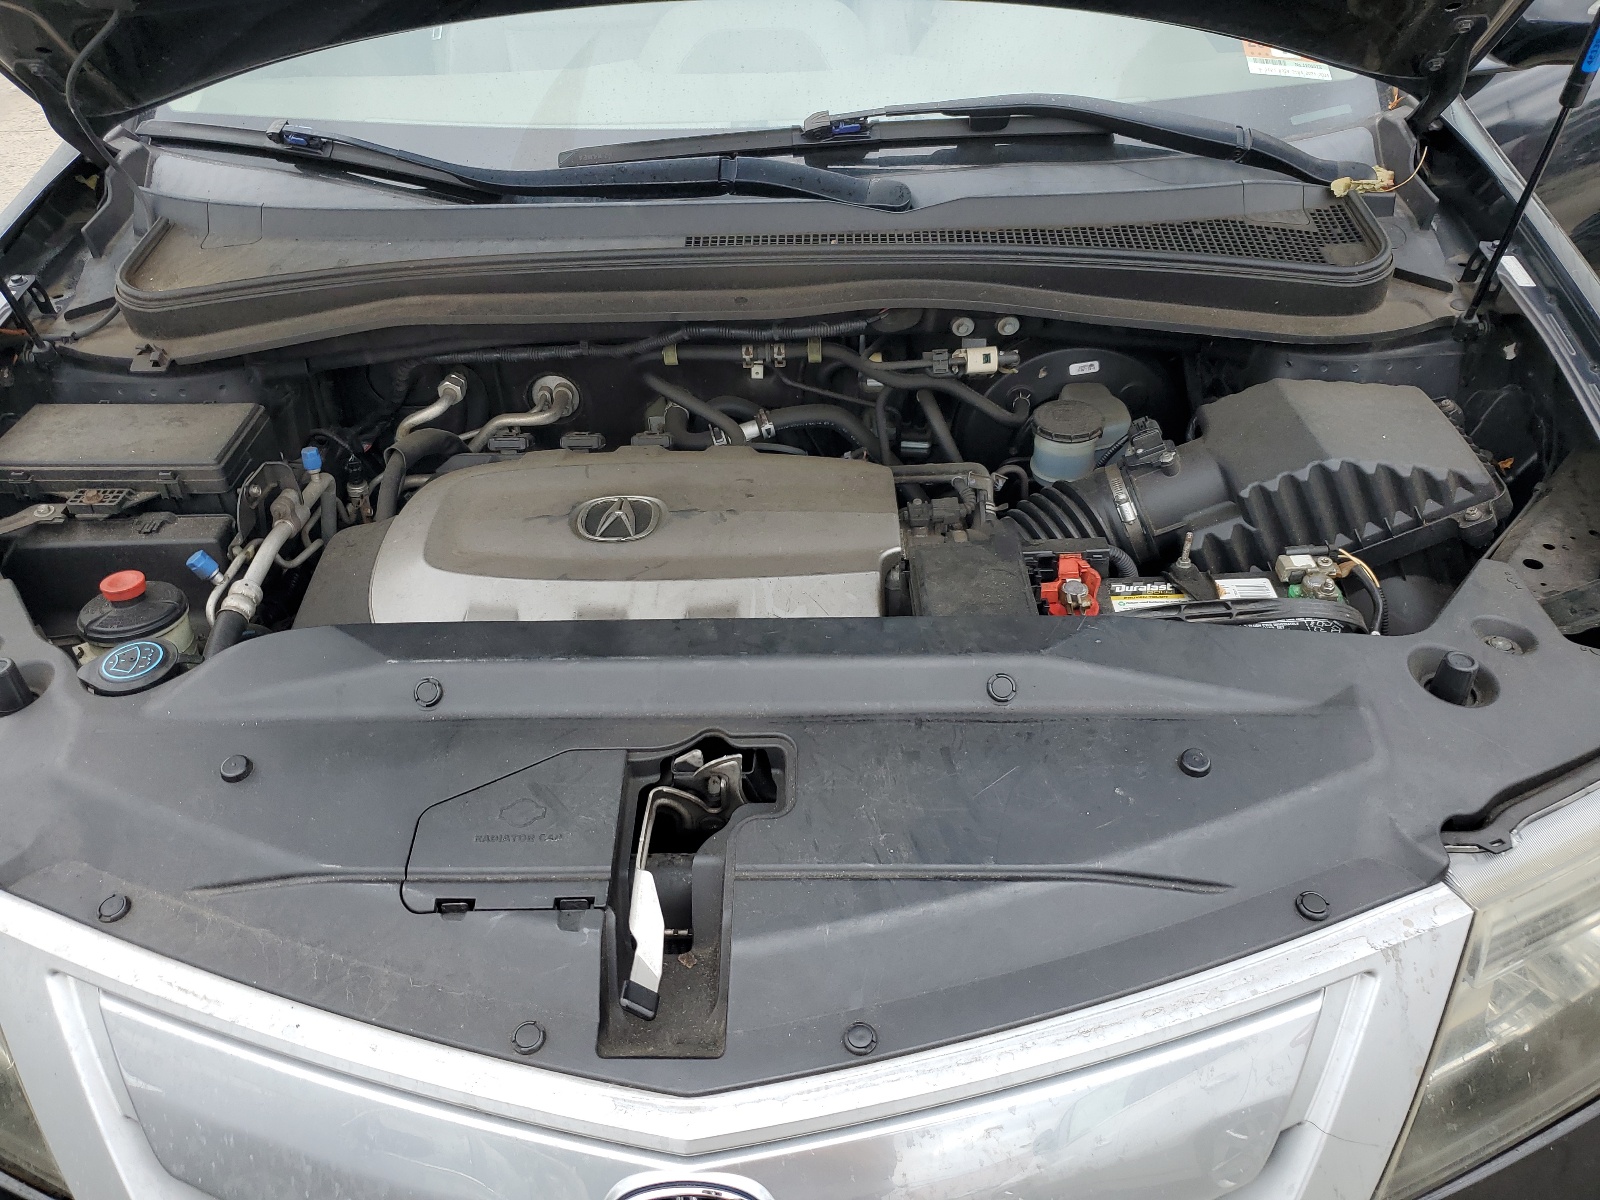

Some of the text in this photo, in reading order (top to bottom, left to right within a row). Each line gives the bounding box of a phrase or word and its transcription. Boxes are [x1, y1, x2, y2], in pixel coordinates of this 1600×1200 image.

[1111, 583, 1173, 592] Duralast
[474, 833, 563, 843] RADIATOR CAP
